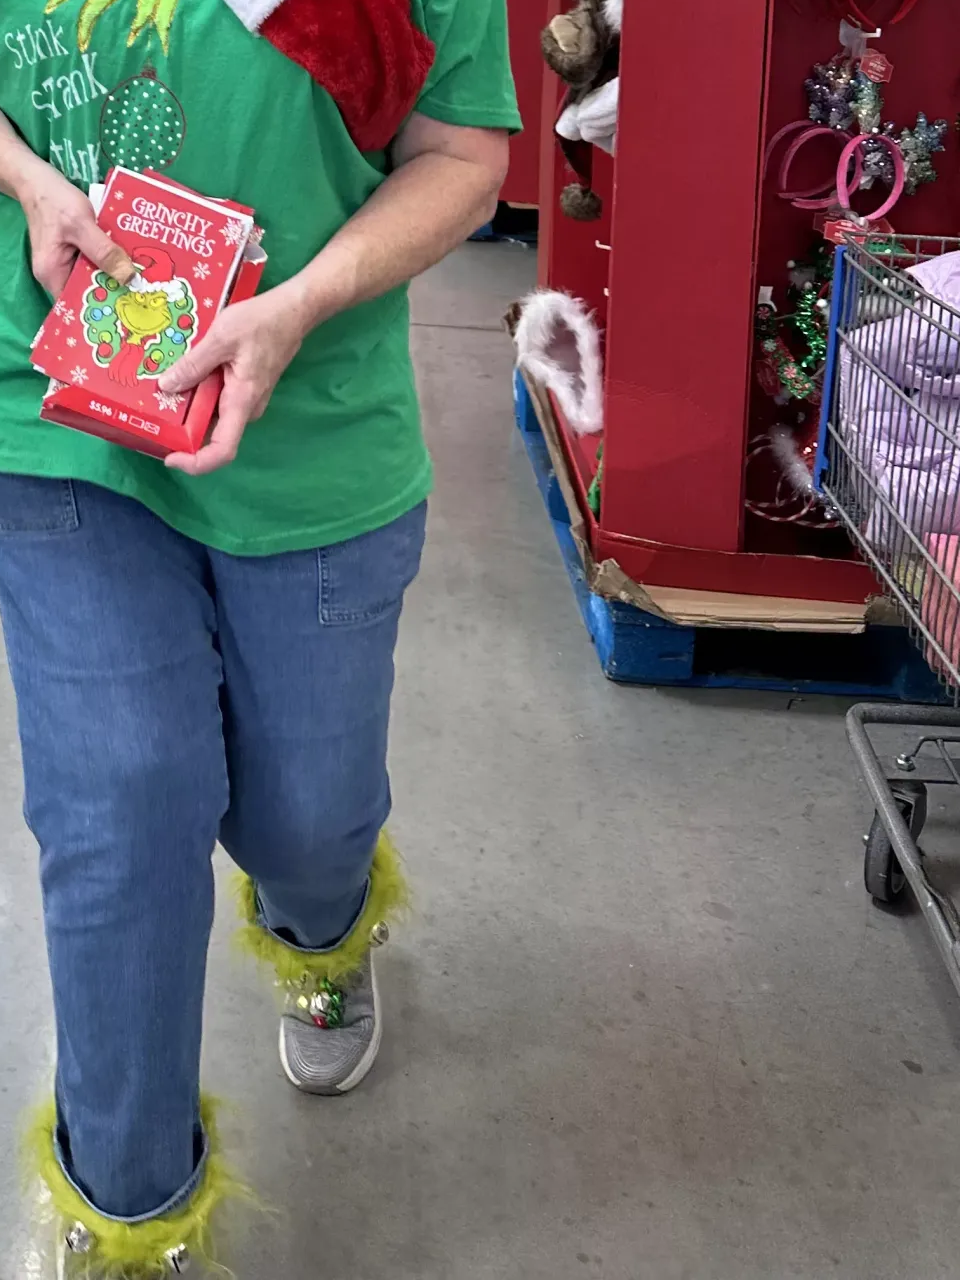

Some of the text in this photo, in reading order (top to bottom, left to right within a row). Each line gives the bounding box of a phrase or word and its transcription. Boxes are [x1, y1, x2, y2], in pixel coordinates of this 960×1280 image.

[116, 213, 216, 258] GREETINGS
[131, 197, 213, 238] GRINCHY
[89, 400, 112, 417] $5.96
